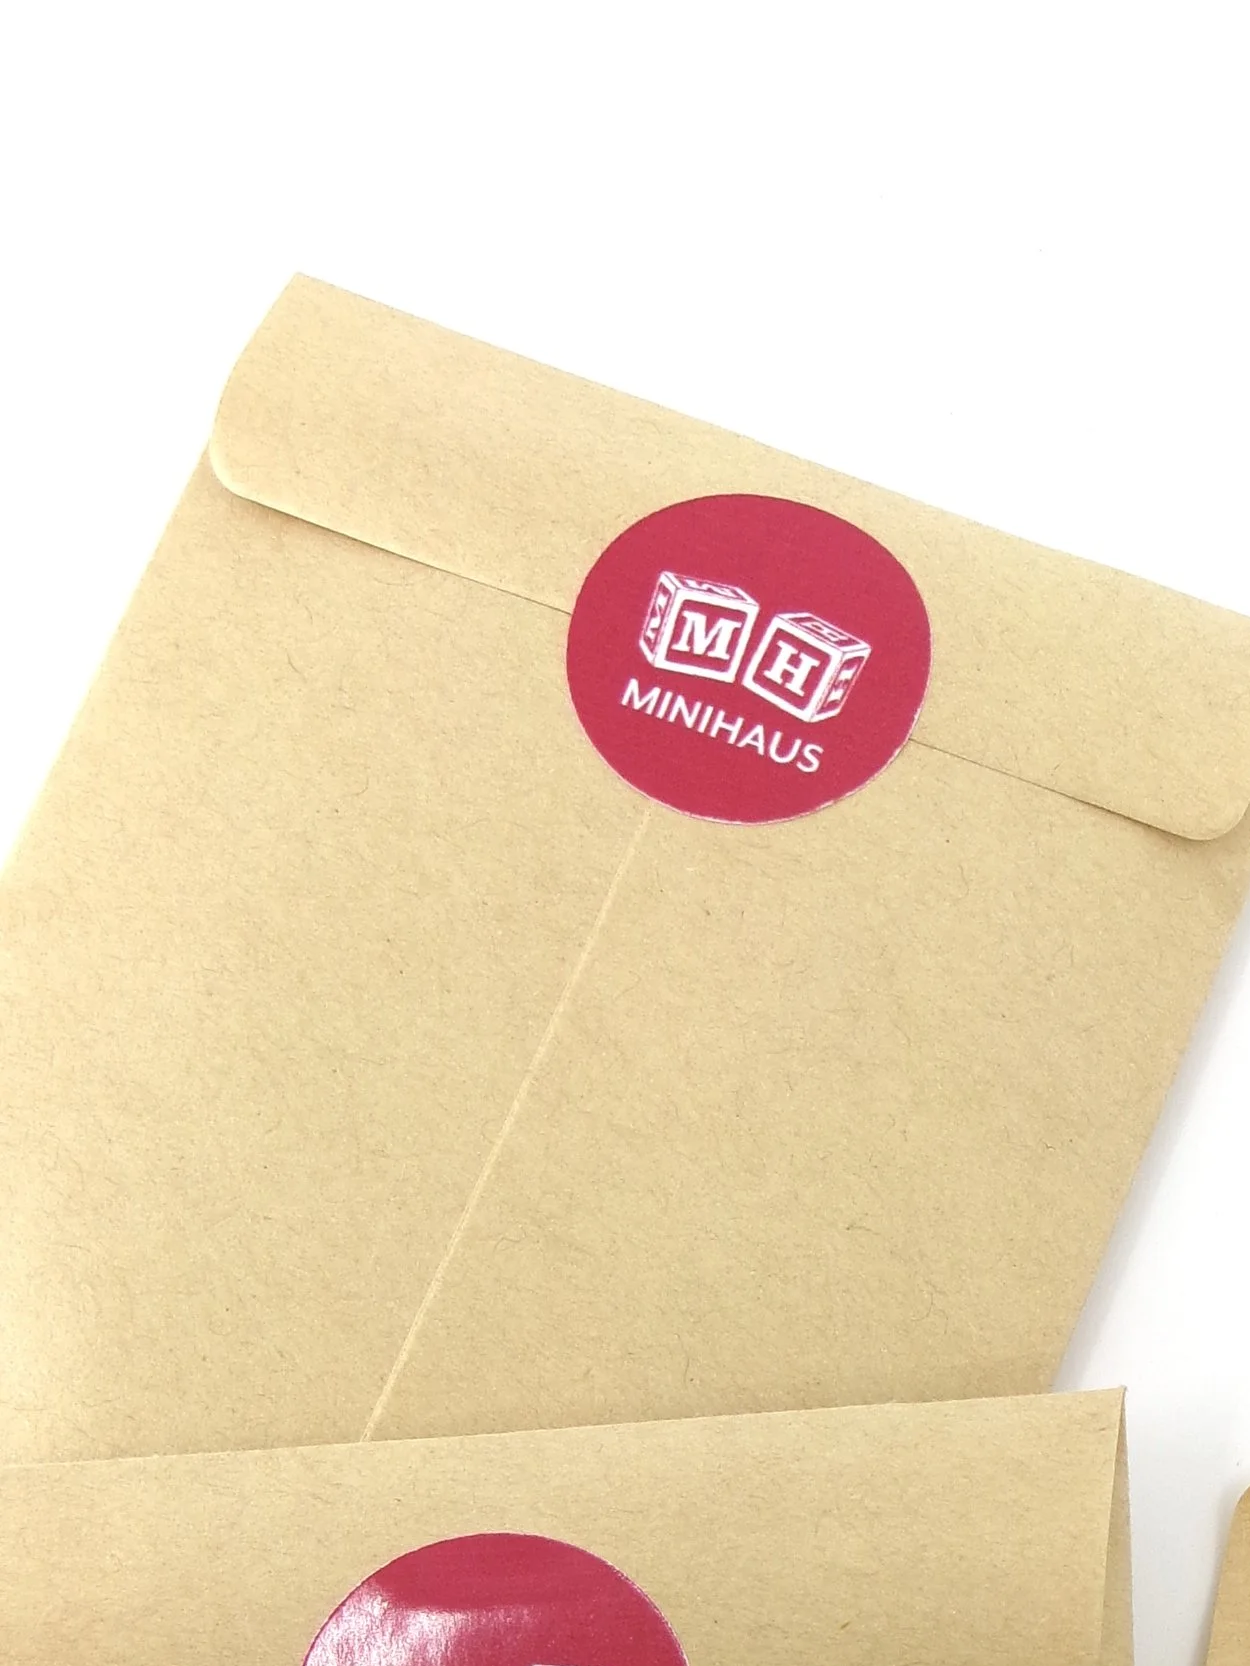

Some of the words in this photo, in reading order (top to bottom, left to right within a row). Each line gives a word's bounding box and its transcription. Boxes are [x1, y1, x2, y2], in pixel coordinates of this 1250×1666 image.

[671, 611, 742, 660] M
[763, 640, 820, 697] H
[621, 678, 824, 773] MINIHAUS
